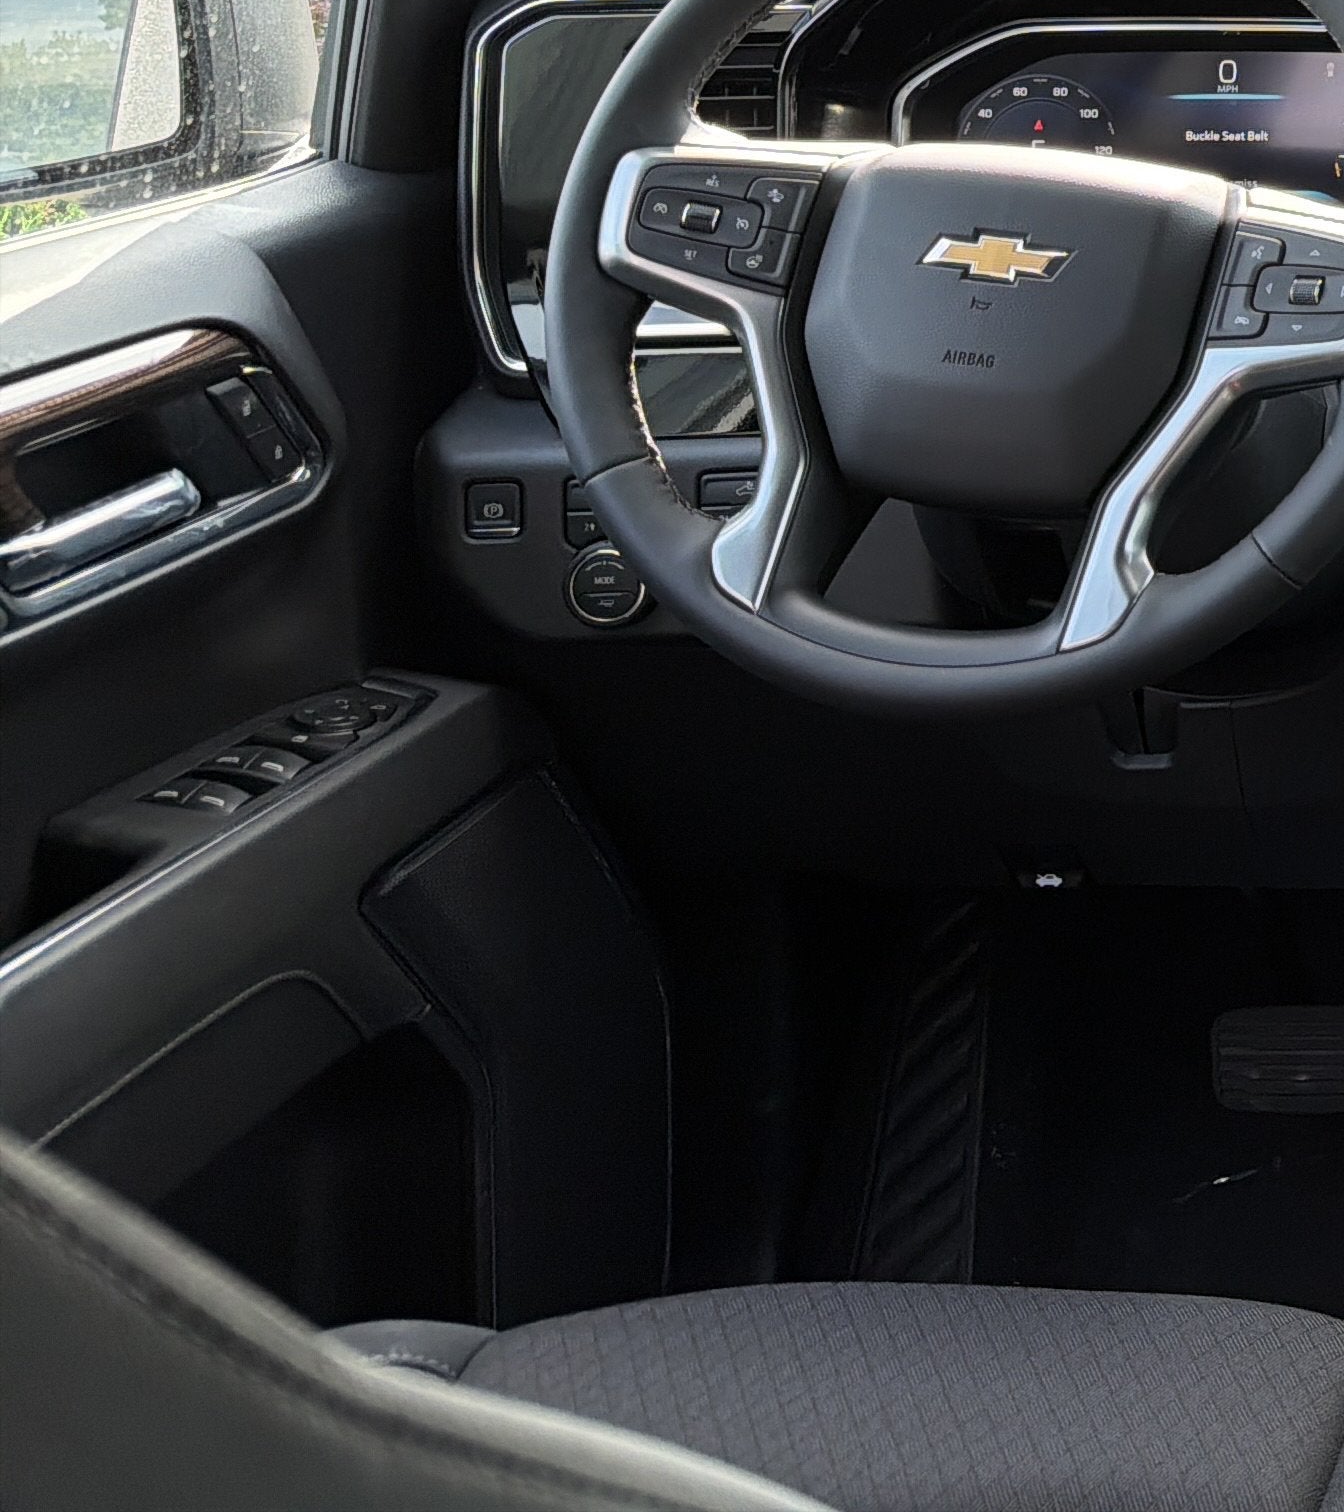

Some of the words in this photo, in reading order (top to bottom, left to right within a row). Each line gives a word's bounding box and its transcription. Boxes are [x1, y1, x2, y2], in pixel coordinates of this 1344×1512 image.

[1218, 59, 1237, 84] 0
[1012, 87, 1028, 96] 60
[1052, 87, 1069, 96] 80
[1217, 84, 1239, 94] MPH
[977, 108, 993, 118] 40
[1079, 108, 1098, 118] 100
[1185, 130, 1220, 142] Buckle
[1222, 130, 1246, 142] Seat
[1247, 130, 1269, 142] Belt
[1094, 145, 1113, 156] 120
[941, 348, 996, 368] AIRBAG
[594, 576, 616, 584] MODE
